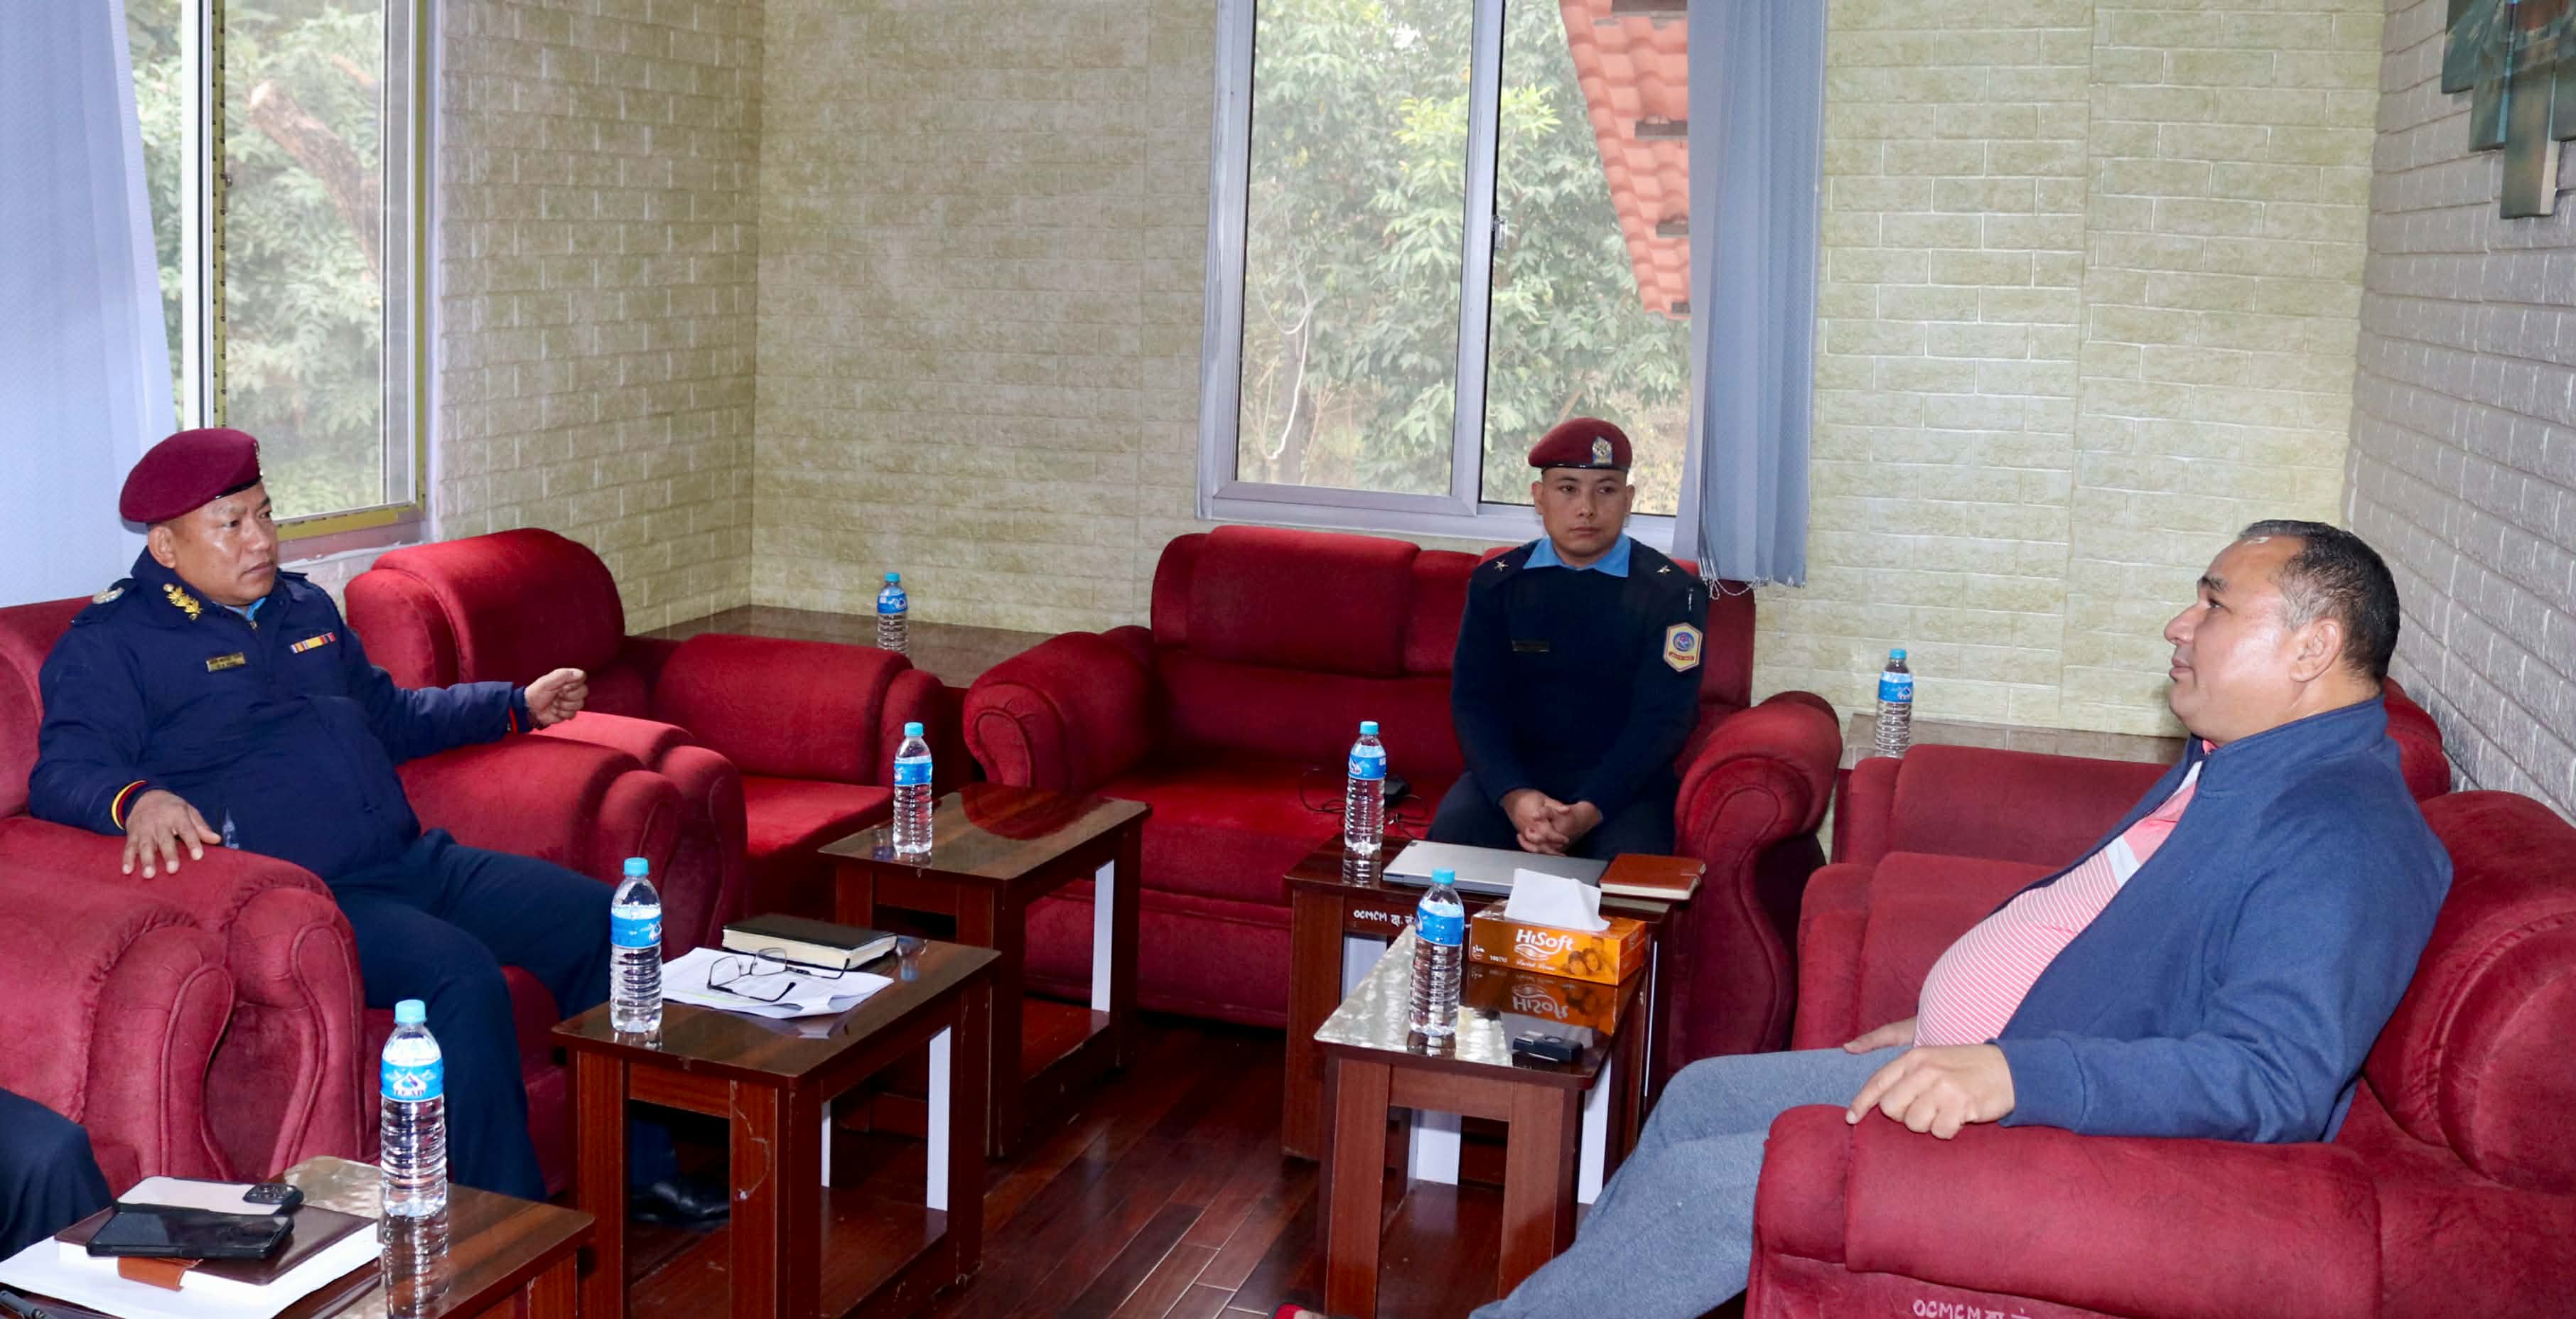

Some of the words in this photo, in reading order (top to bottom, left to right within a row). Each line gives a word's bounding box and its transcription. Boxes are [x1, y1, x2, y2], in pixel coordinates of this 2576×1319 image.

[1353, 909, 1387, 921] OCMCM
[1515, 929, 1575, 951] HiSoft
[1912, 1299, 1981, 1319] OCMCM
